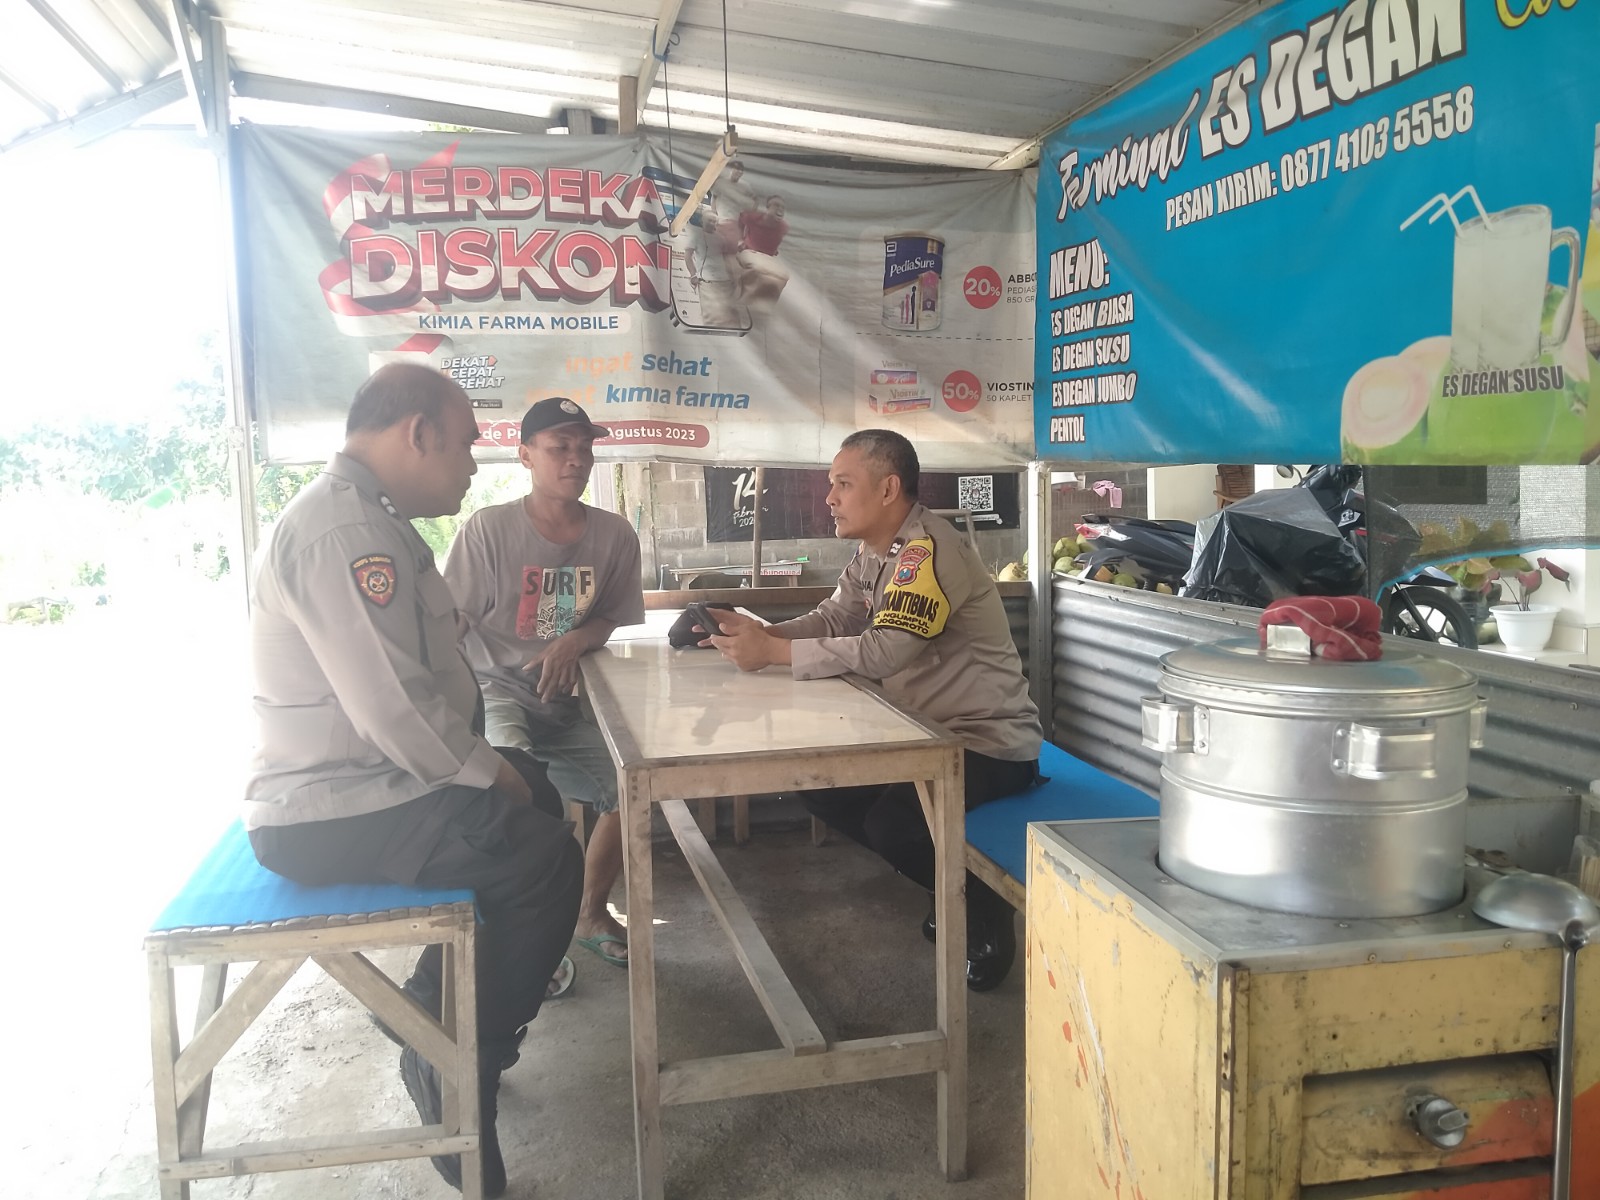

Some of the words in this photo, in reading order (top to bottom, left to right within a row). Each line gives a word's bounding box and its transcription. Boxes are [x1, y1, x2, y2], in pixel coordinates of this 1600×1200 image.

[1057, 91, 1200, 221] Terminal
[1199, 55, 1256, 158] ES
[1260, 0, 1463, 131] DEGAN
[1166, 183, 1214, 231] PESAN
[1215, 161, 1278, 213] KIRIM:
[1280, 139, 1331, 192] 0877
[1335, 116, 1390, 172] 4103
[1393, 85, 1474, 151] 5558
[350, 166, 668, 228] MERDEKA
[350, 228, 672, 308] DISKON
[890, 256, 935, 277] PediaSure
[1050, 238, 1110, 299] MENU:
[965, 277, 1001, 297] 20%
[1007, 285, 1036, 294] PEDIAS
[1006, 296, 1023, 304] 850
[418, 315, 473, 329] KIMIA
[479, 315, 545, 329] FARMA
[551, 315, 619, 330] MOBILE
[1051, 310, 1062, 337] ES
[1064, 302, 1096, 334] DEGAN
[1097, 293, 1134, 326] BIASA
[441, 355, 489, 369] DEKAT
[1053, 345, 1061, 372] ES
[1063, 340, 1094, 371] DEGAN
[1096, 335, 1130, 365] SUSU
[450, 366, 496, 379] CEPAT
[565, 351, 633, 380] ingat
[641, 350, 713, 377] sehat
[459, 377, 505, 389] SEHAT
[943, 382, 979, 400] 50%
[987, 382, 1034, 392] VIOSTIN
[1053, 383, 1062, 407] ES
[1063, 378, 1095, 406] DEGAN
[1097, 372, 1137, 403] JUMBO
[1442, 375, 1458, 397] ES
[1461, 370, 1510, 396] DEGAN
[1513, 365, 1565, 392] SUSU
[605, 384, 671, 404] kimia
[675, 385, 750, 409] farma
[986, 394, 997, 402] 50
[999, 394, 1032, 402] KAPLET
[607, 426, 662, 440] Agustus
[665, 427, 696, 441] 2023
[1050, 416, 1085, 442] PENTOL
[739, 516, 755, 527] 202
[525, 570, 592, 596] SURF
[877, 618, 929, 634] JOGOROTO
[883, 612, 930, 629] NGUMPUL
